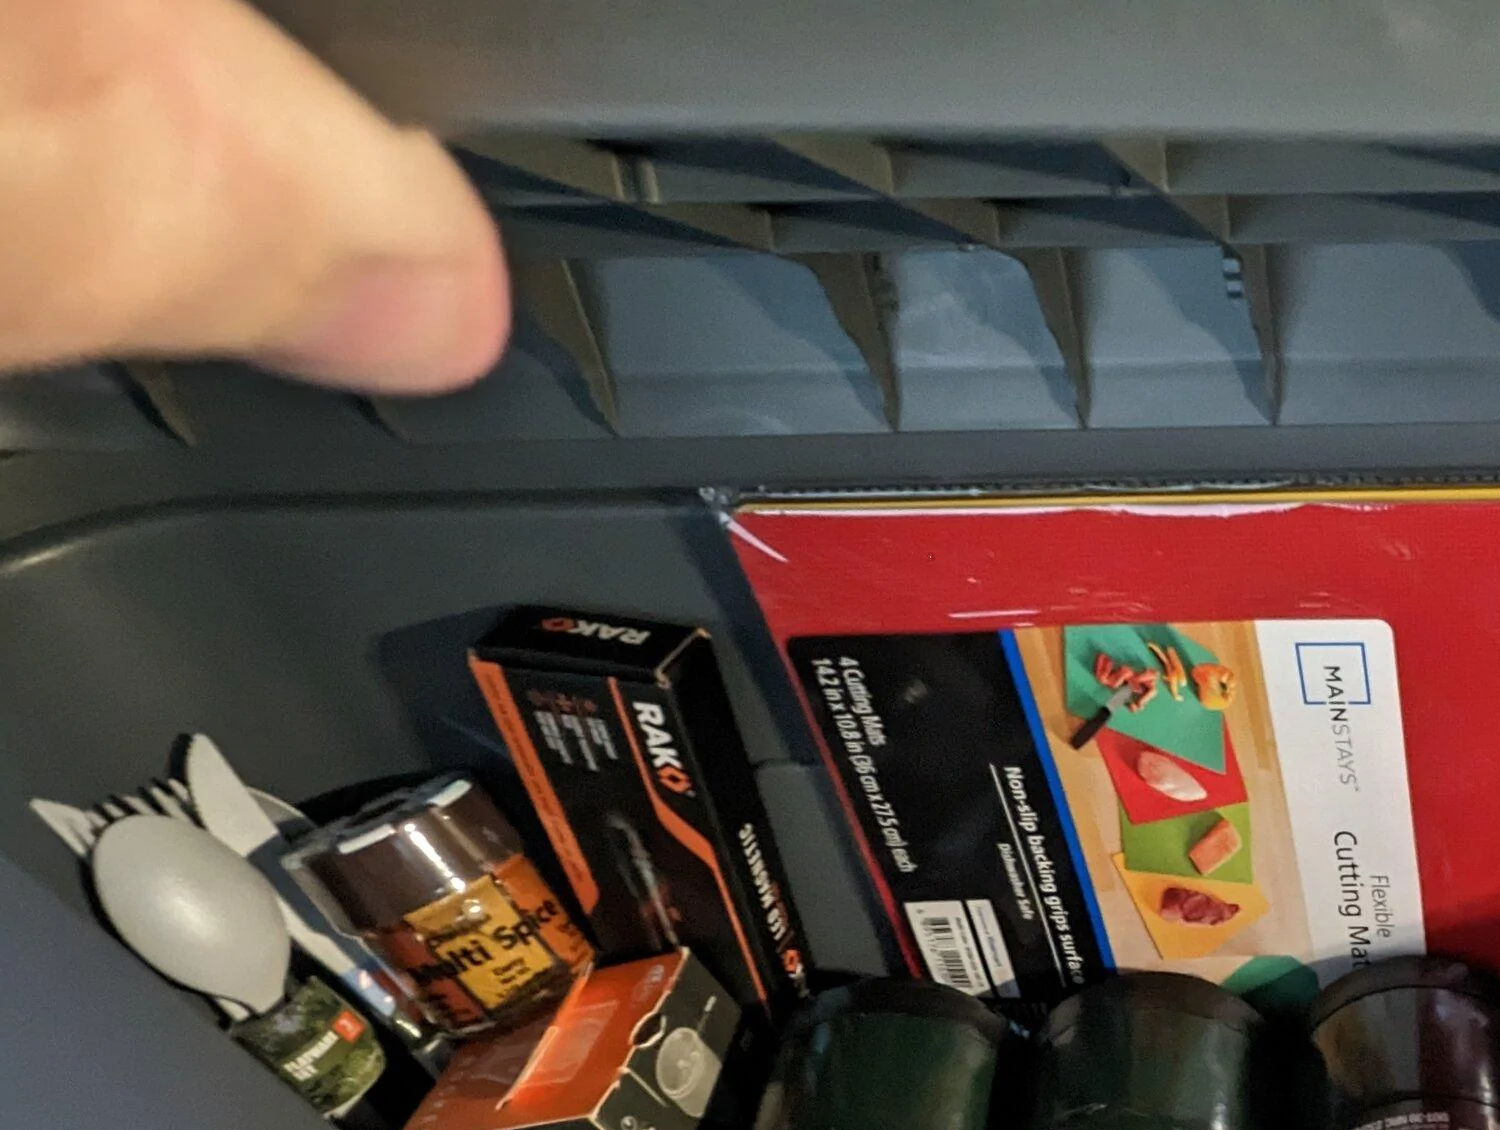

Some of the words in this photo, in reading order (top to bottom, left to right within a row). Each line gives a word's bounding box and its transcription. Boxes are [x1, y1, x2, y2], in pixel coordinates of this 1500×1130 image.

[842, 668, 874, 714] Cutting
[860, 714, 887, 747] Mats
[1003, 765, 1040, 832] Non-slip
[1027, 834, 1058, 893] backing
[1045, 894, 1072, 932] grips
[1334, 830, 1363, 917] Cutting
[1369, 875, 1396, 939] Flexible
[1348, 925, 1372, 969] Mat
